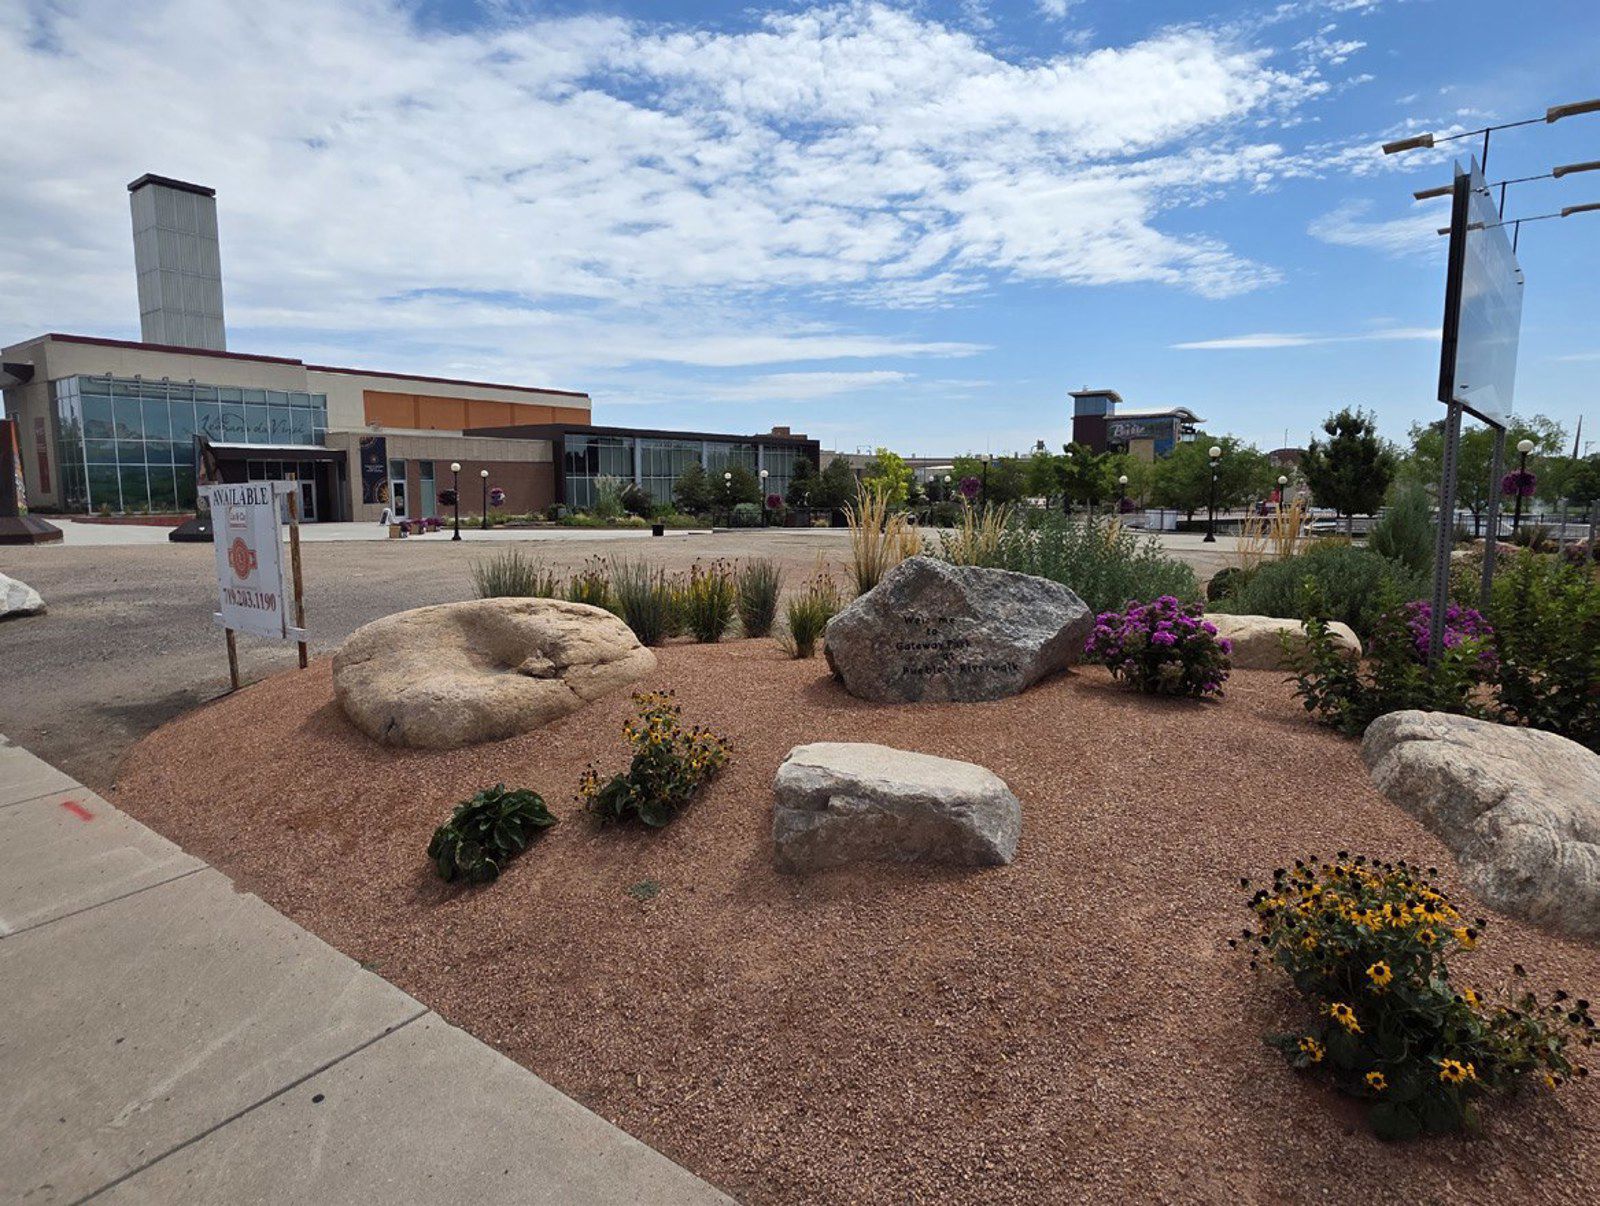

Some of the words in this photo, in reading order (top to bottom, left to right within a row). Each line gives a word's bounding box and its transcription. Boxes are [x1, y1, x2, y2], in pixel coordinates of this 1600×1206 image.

[254, 422, 267, 433] da
[272, 418, 304, 434] Vinci
[213, 487, 269, 506] AVAILABLE
[904, 614, 956, 624] Welcme
[926, 628, 938, 636] to
[896, 641, 944, 651] Gateway
[947, 639, 970, 648] Park
[943, 652, 955, 660] at
[960, 661, 1019, 674] Riverwalk
